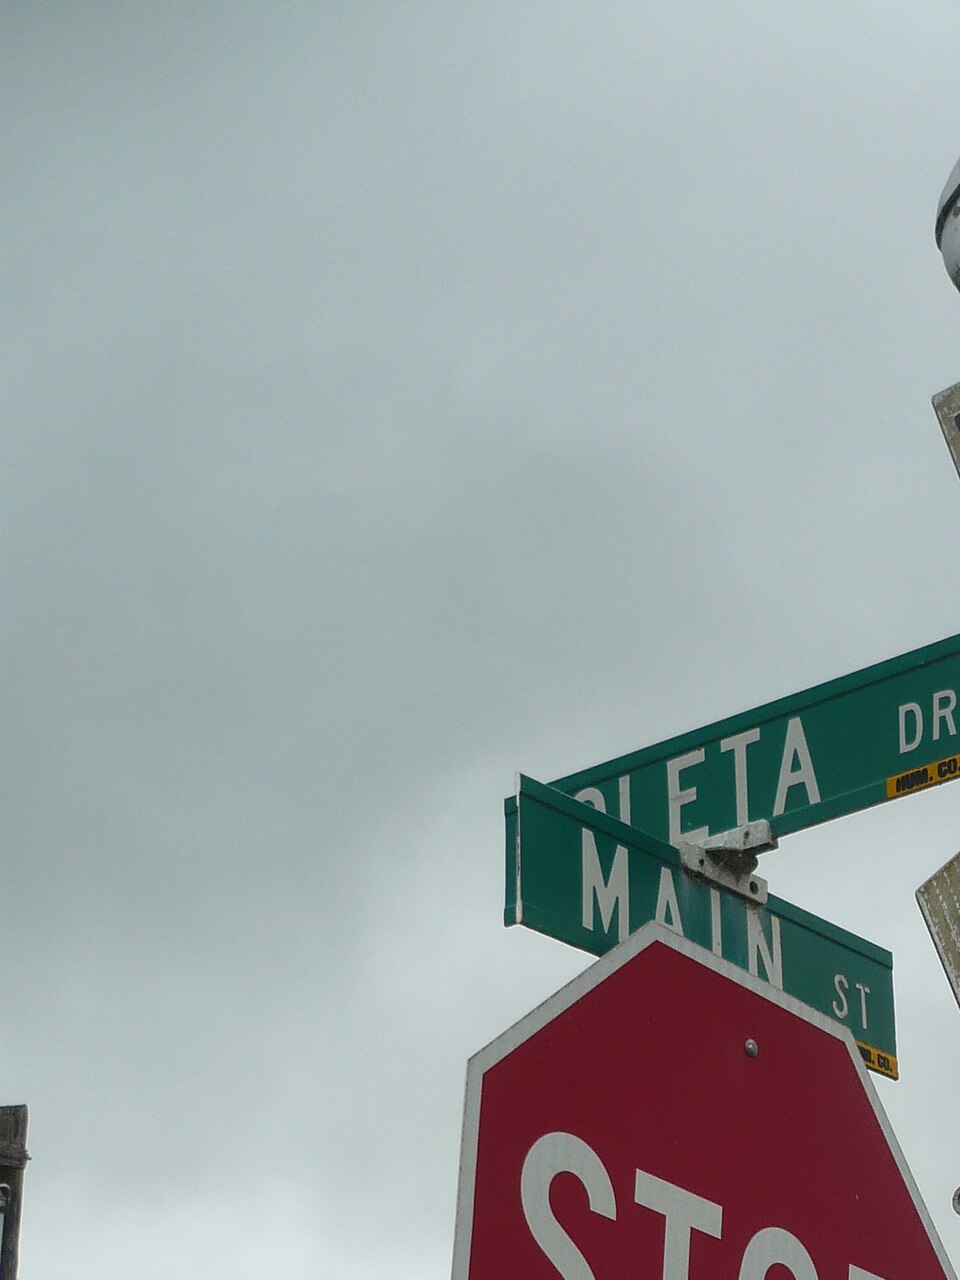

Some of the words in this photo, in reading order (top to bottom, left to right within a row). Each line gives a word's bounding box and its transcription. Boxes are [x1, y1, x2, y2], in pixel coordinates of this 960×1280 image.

[898, 688, 958, 754] DR
[581, 826, 784, 992] MAIN
[832, 973, 871, 1030] ST
